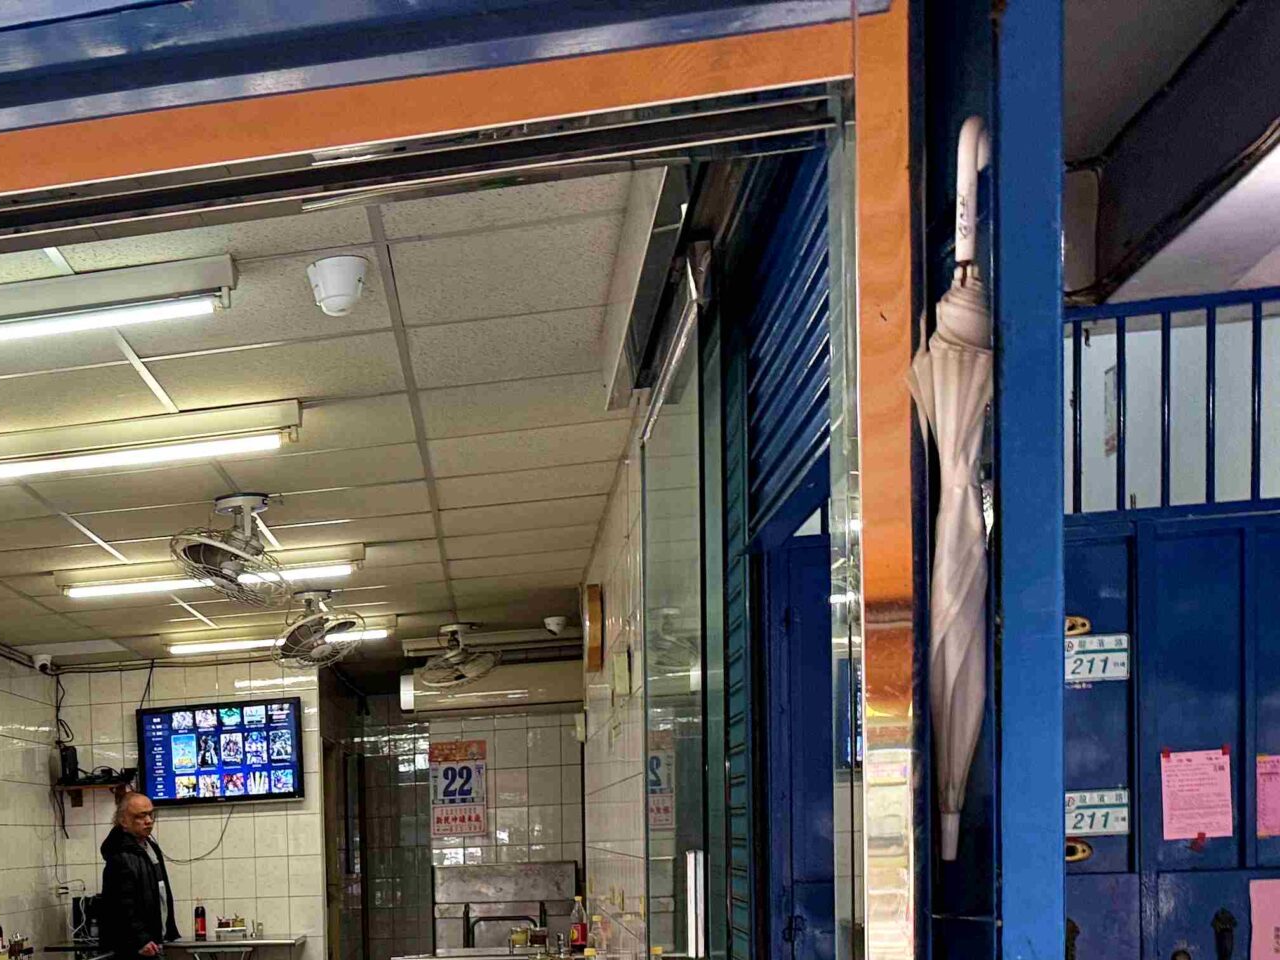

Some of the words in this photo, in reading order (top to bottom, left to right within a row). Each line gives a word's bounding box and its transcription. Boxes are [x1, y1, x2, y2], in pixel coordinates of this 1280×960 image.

[1070, 656, 1109, 675] 211
[442, 765, 473, 798] 22
[1072, 811, 1110, 829] 211
